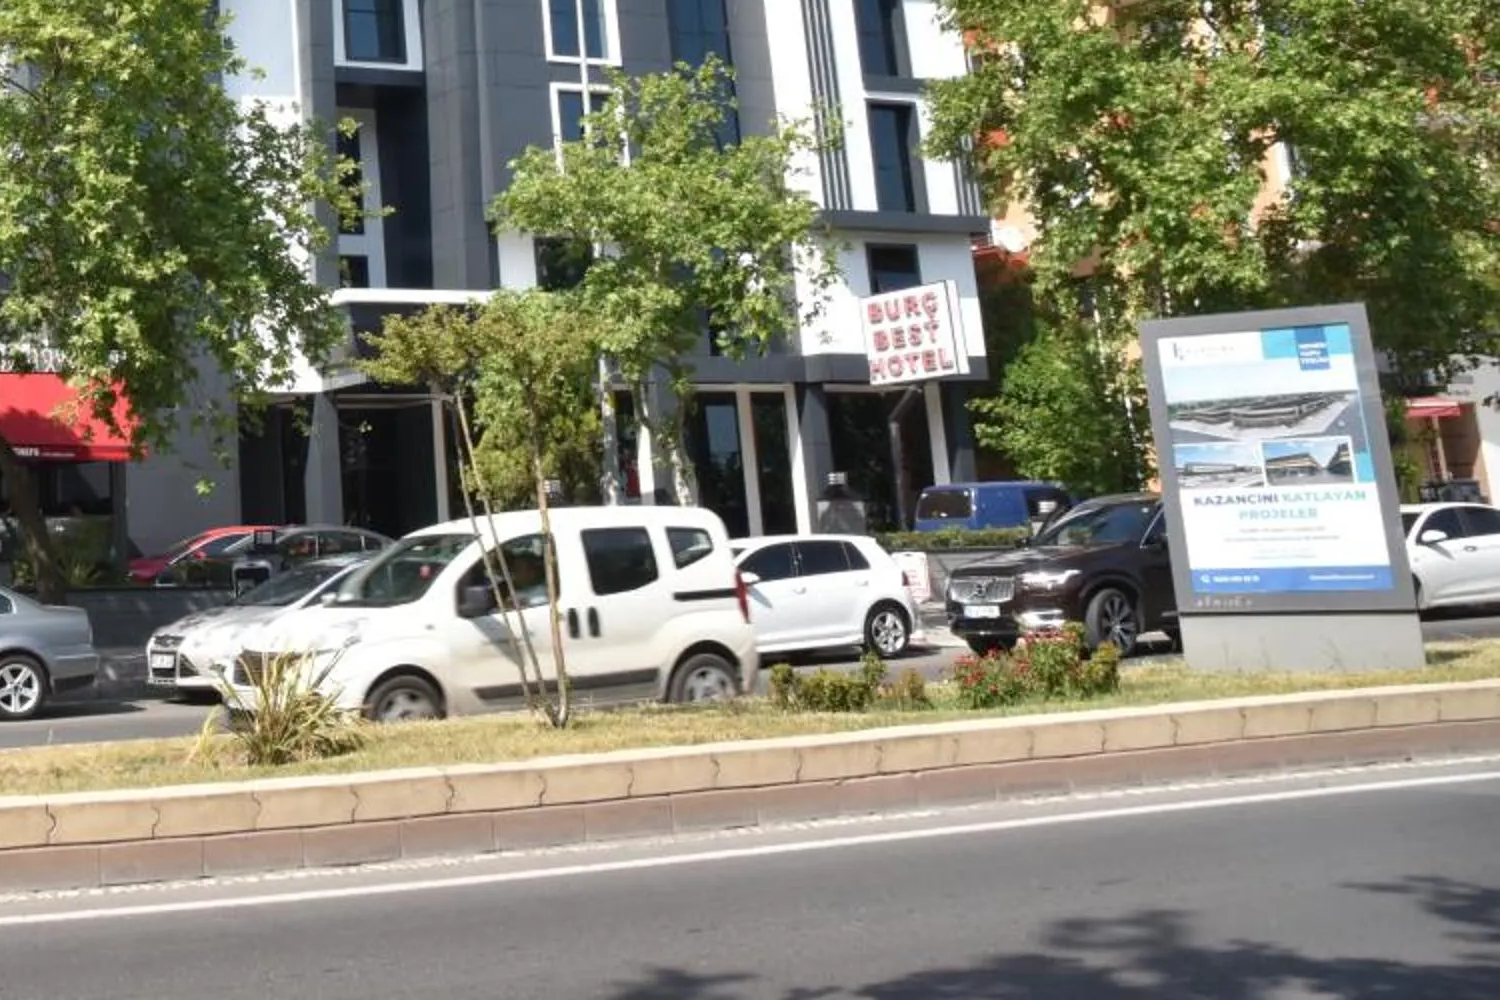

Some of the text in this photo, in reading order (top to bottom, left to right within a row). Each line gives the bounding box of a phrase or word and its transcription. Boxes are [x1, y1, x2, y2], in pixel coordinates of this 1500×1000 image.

[867, 291, 939, 324] BURÇ
[873, 320, 940, 352] BEST
[869, 347, 954, 381] HOTEL
[1280, 489, 1367, 503] KATLAYAN
[1238, 507, 1319, 521] PROJELER
